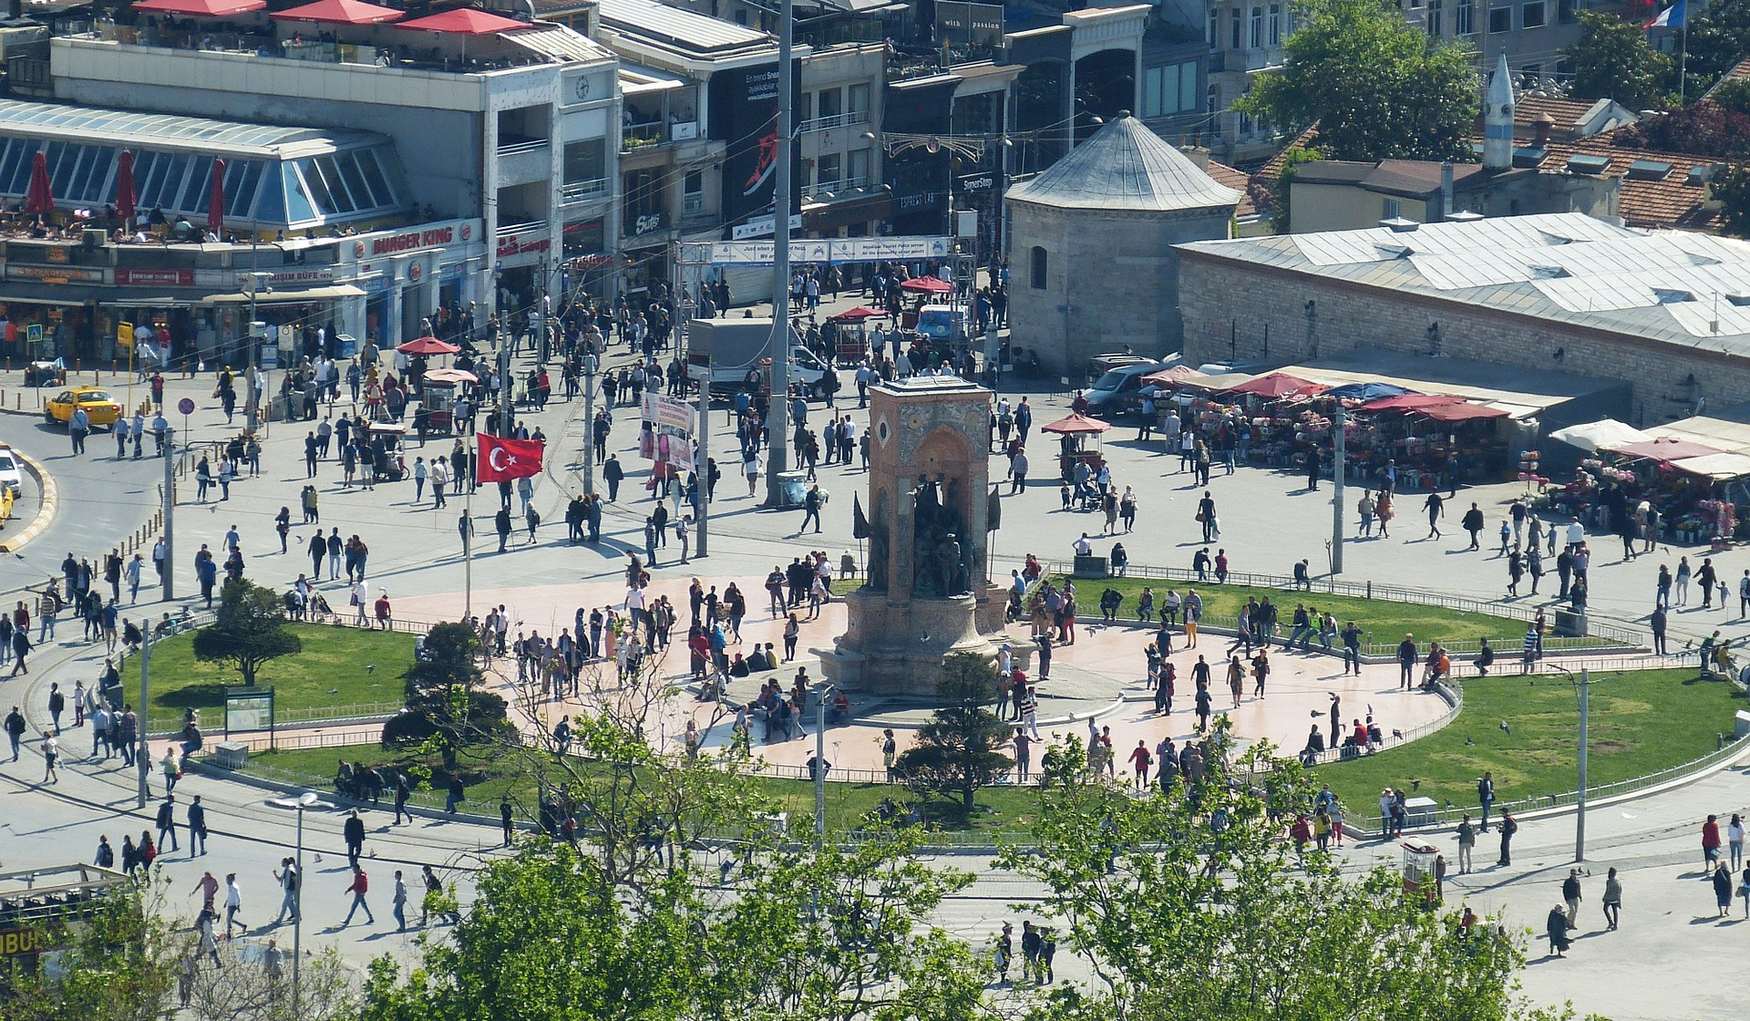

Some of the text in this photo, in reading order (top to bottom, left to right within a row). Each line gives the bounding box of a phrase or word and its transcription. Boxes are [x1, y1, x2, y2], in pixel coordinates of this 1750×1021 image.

[963, 178, 993, 192] SuperStep
[372, 226, 453, 255] BURGER KING
